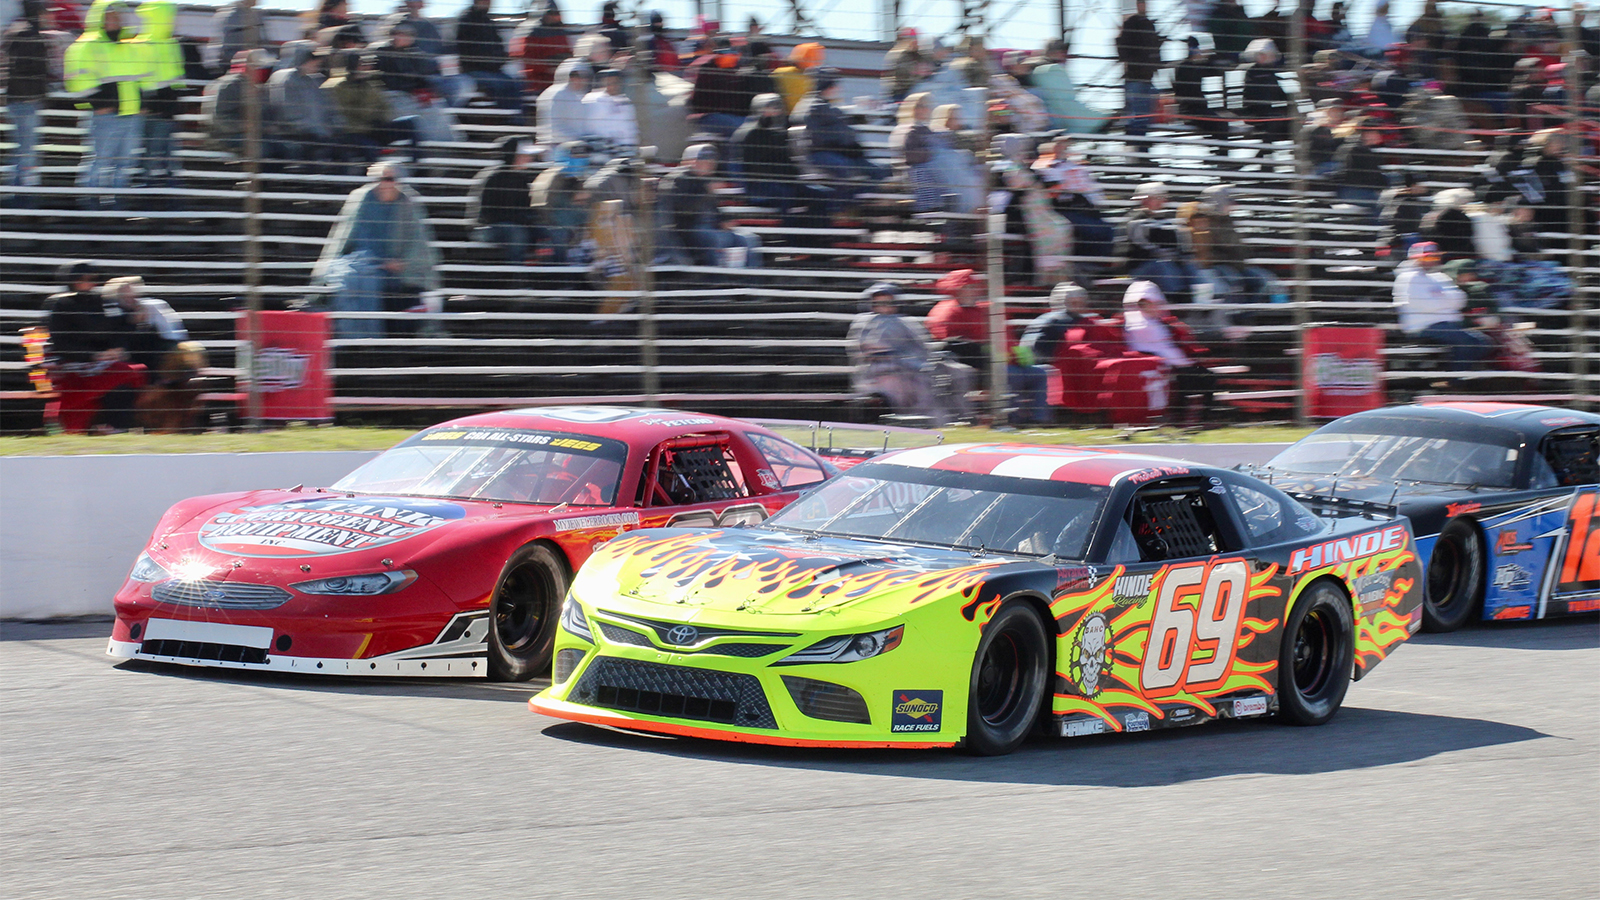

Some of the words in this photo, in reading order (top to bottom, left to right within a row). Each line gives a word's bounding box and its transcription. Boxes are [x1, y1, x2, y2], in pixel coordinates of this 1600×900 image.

[463, 431, 490, 441] CRA
[488, 432, 552, 446] ALL-STARS
[550, 438, 602, 452] JEGS
[246, 510, 416, 537] CRYOGENIC
[316, 502, 444, 527] TANK
[204, 522, 378, 549] EQUIPMENT
[1288, 525, 1404, 575] HINDE
[1113, 574, 1153, 598] HINDE
[1113, 595, 1148, 609] Racing
[1141, 558, 1248, 692] 69
[897, 704, 937, 713] SUNOCO
[1243, 700, 1266, 712] brembo
